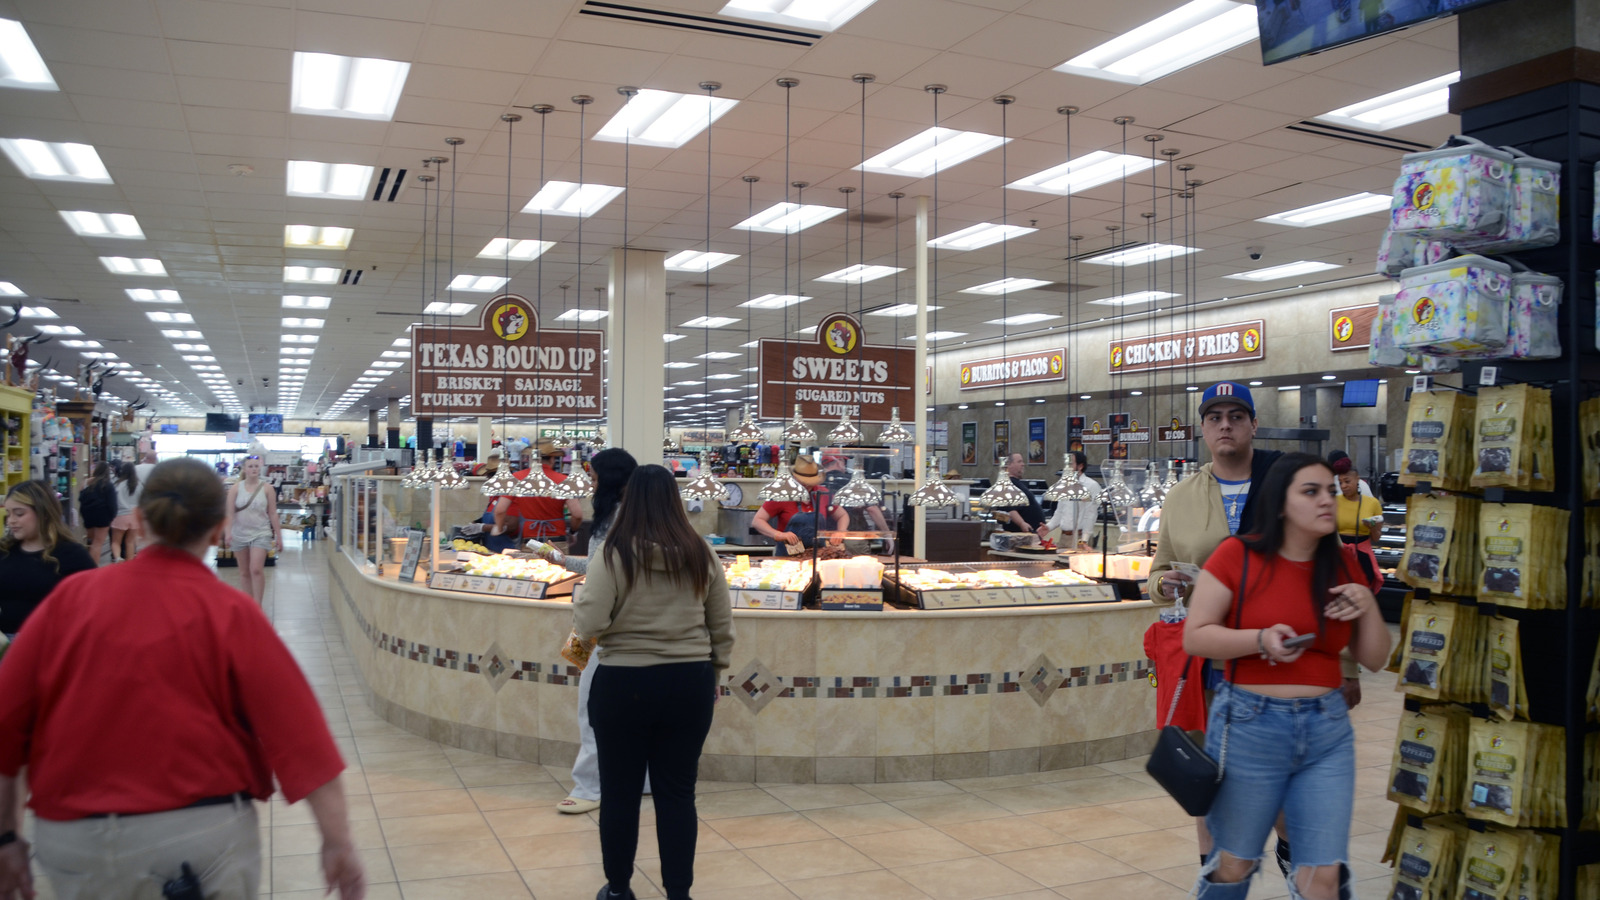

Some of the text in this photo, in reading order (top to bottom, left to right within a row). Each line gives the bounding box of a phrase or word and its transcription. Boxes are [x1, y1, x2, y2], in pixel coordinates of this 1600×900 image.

[419, 343, 596, 371] TEXAS ROUND UP
[1125, 331, 1240, 365] CHICKEN & FRIES
[792, 356, 888, 383] SWEETS
[971, 357, 1049, 383] BURRITOS & TACOS
[437, 376, 582, 391] BRISKET SAUSAGE
[421, 393, 596, 408] TURKEY PULLED PORK
[795, 389, 885, 404] SUGARED NUTS
[820, 404, 860, 416] FUDGE
